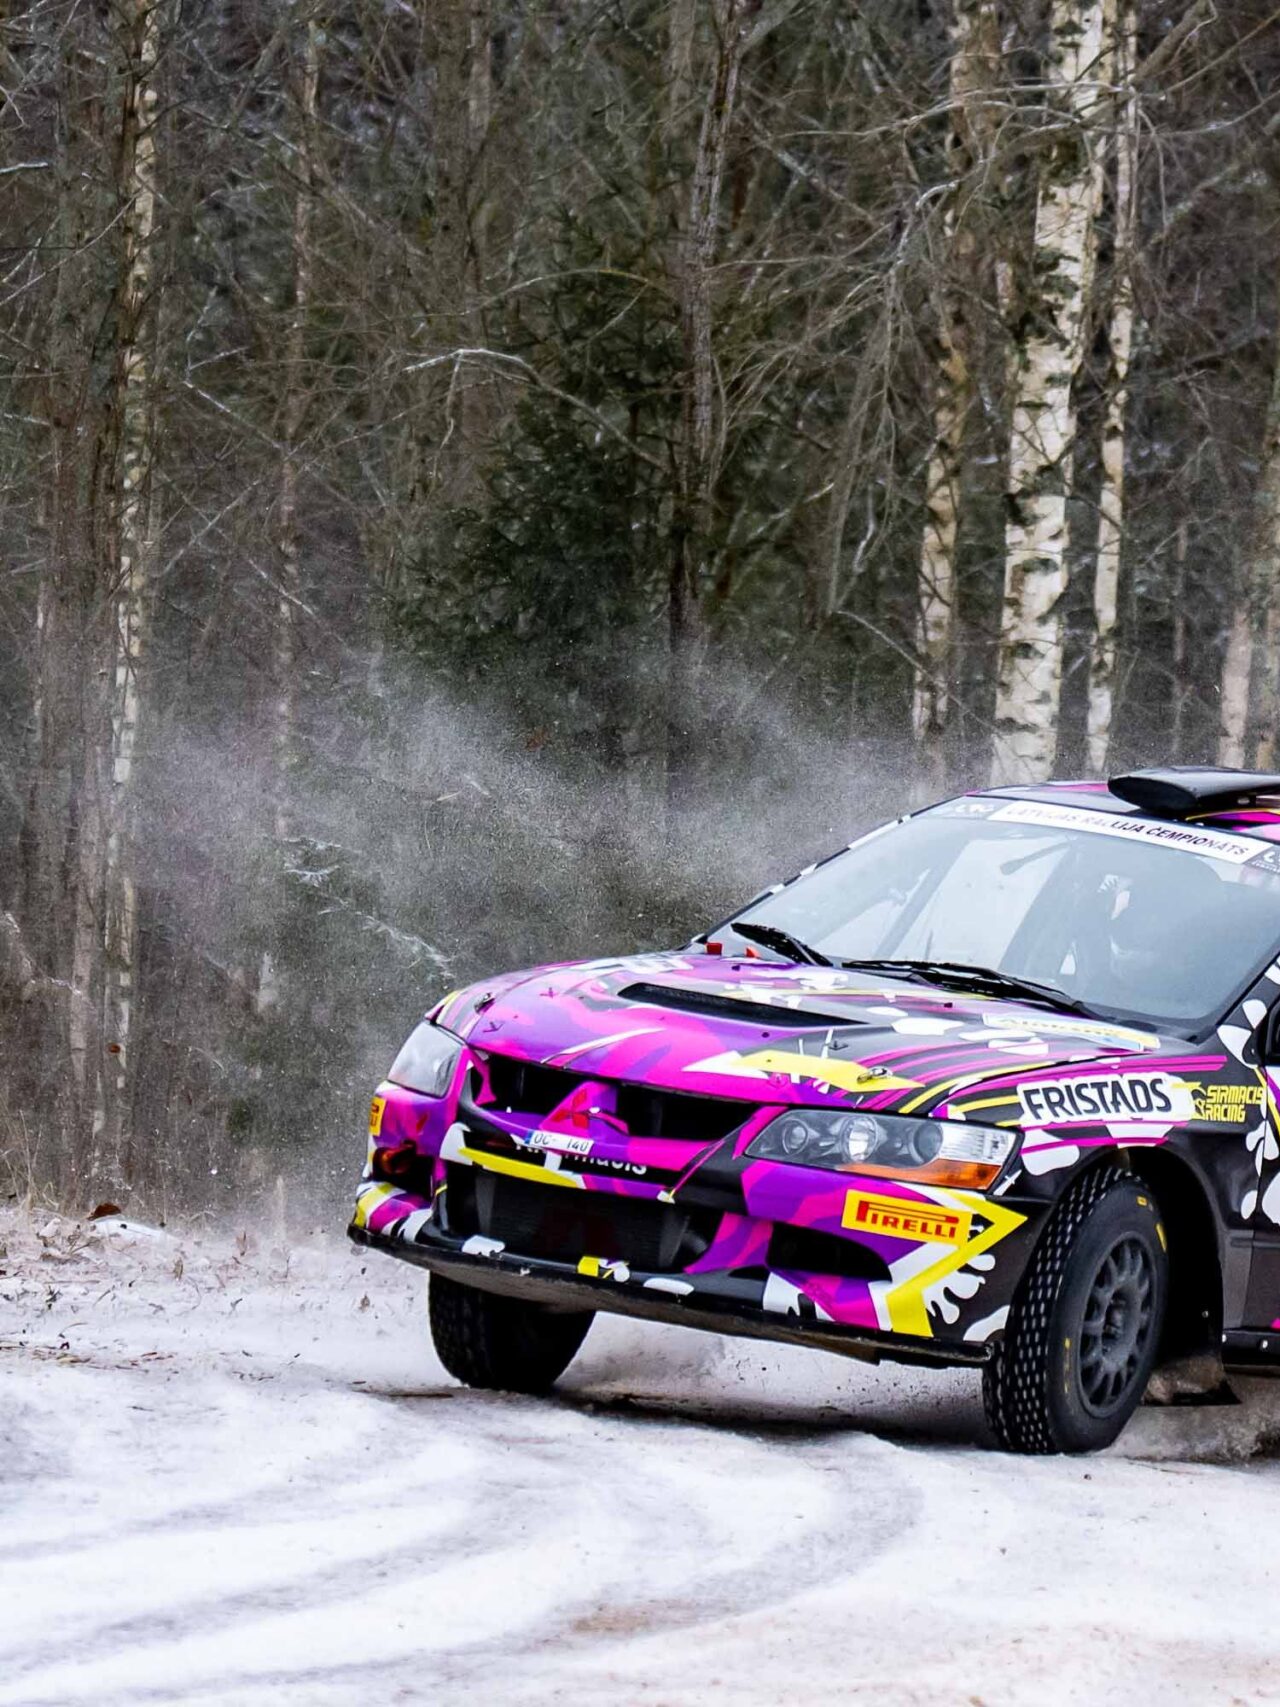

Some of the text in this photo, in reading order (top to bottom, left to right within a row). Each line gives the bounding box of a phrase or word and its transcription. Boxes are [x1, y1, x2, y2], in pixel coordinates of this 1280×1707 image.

[1023, 1078, 1173, 1121] FRISTADS
[1207, 1085, 1263, 1104] SIRMACIS
[1205, 1104, 1246, 1123] RACING
[856, 1200, 959, 1239] PIRELLI
